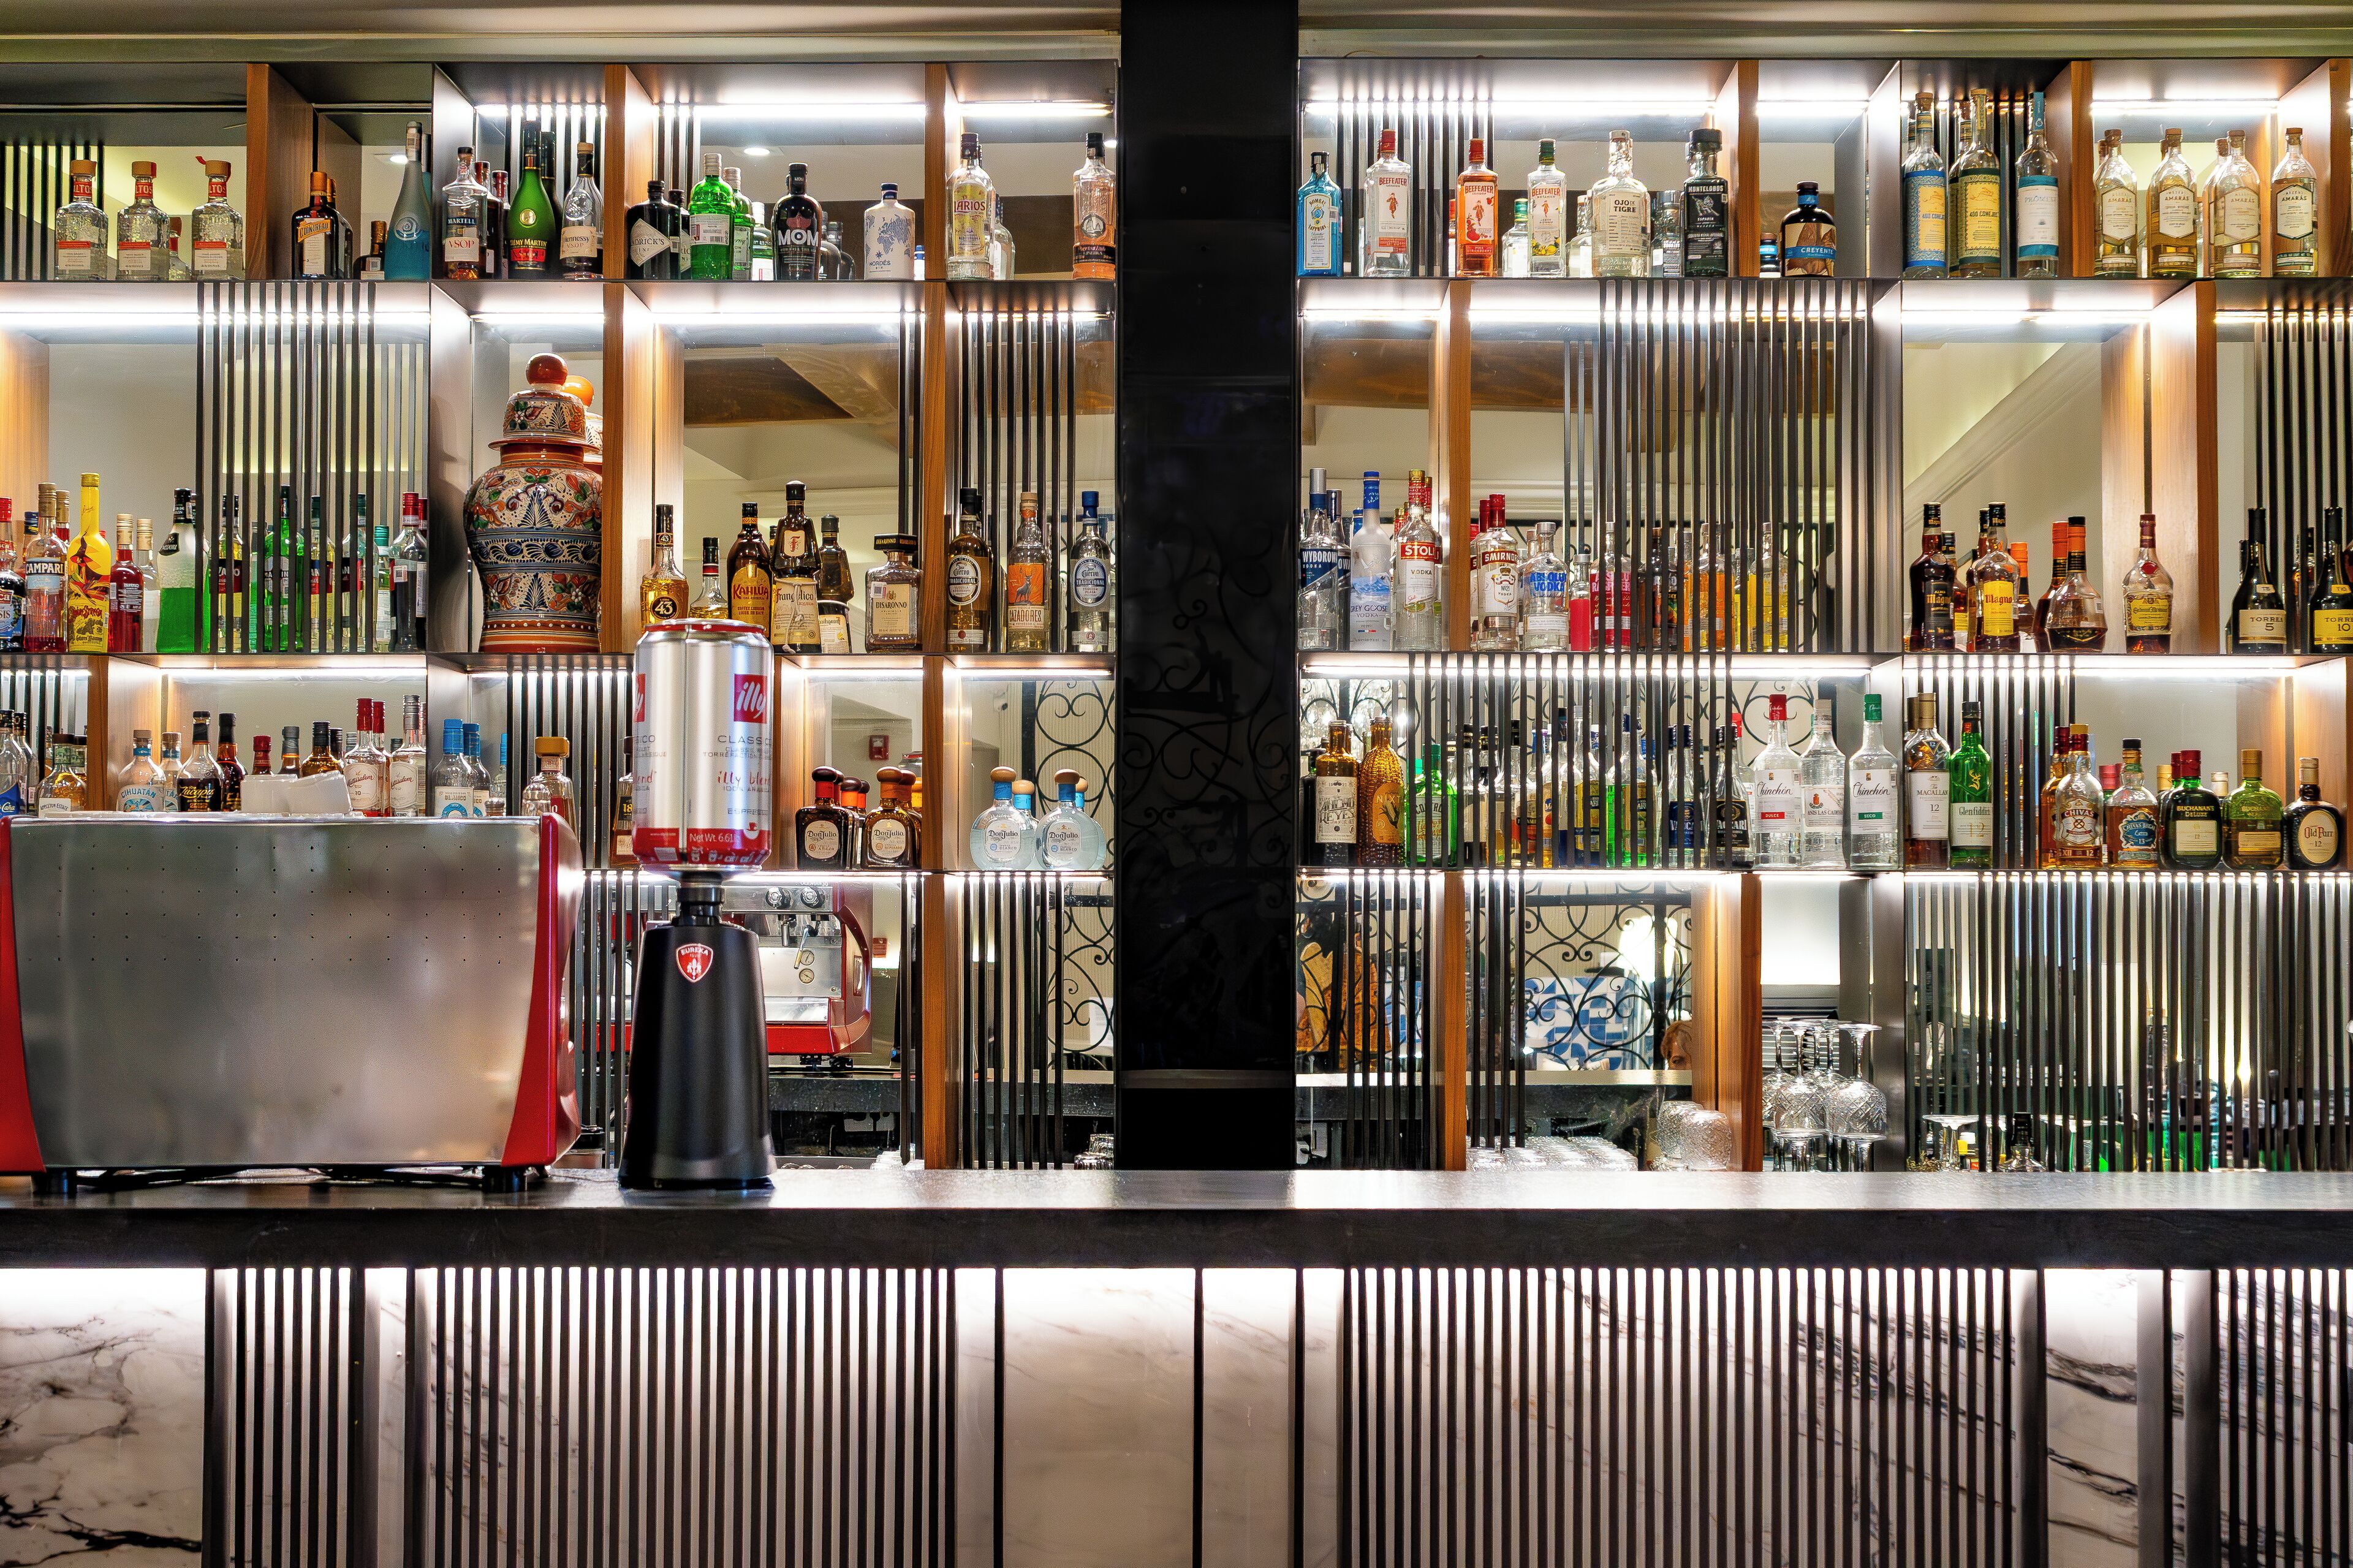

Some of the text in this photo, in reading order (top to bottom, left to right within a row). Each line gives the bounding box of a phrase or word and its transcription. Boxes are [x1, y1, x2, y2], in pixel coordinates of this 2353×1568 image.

[1379, 176, 1408, 187] BEEFEATER
[1464, 185, 1494, 194] BEEFEATER
[1532, 187, 1561, 197] BEEFEATER
[954, 200, 986, 213] LARIOS
[778, 229, 819, 246] MOM
[26, 562, 64, 574] CAMPARI
[1082, 569, 1099, 578] Cuervo
[1534, 582, 1565, 593] VODKA
[0, 593, 11, 602] ca
[776, 588, 814, 604] Franglico
[1985, 594, 2013, 606] Magno
[654, 600, 673, 615] 43
[1009, 610, 1042, 623] CAZADORES
[2265, 623, 2275, 632] 5
[2338, 623, 2351, 632] 10
[736, 681, 767, 719] illy
[121, 787, 157, 798] CIHUATÁN
[1756, 781, 1793, 796] Chinchón
[1853, 781, 1891, 797] Chinchón
[1376, 794, 1400, 804] NIXT
[2064, 809, 2095, 817] CHIVAS
[2303, 826, 2317, 839] Old
[680, 946, 709, 956] EUREKA
